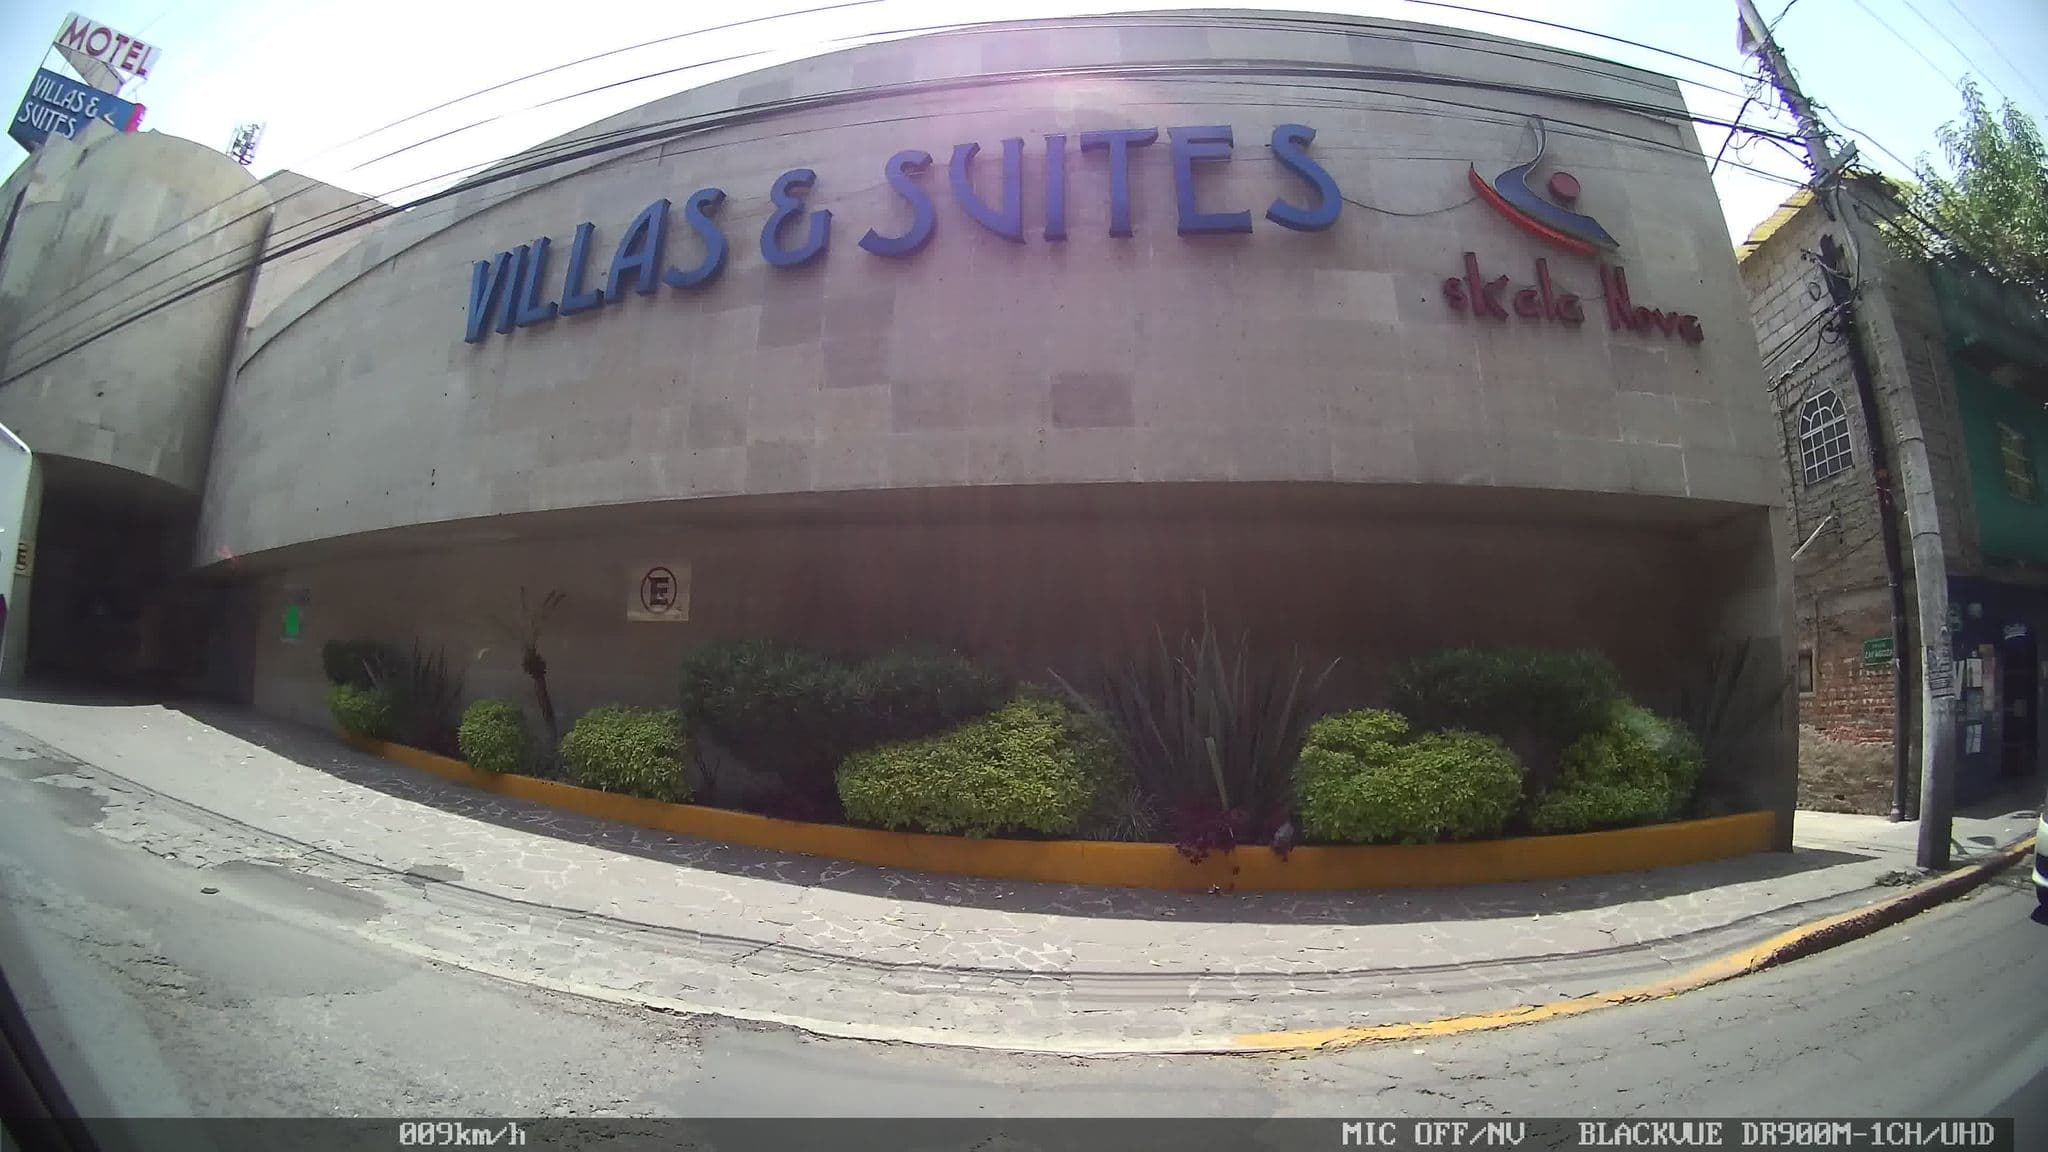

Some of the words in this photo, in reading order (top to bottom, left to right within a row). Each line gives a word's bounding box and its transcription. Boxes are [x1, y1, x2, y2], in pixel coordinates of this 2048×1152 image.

[58, 15, 152, 76] MOTEL
[17, 101, 77, 139] SUITES
[31, 74, 87, 114] VILLAS
[85, 96, 100, 118] &
[464, 187, 728, 344] VILLAS
[760, 169, 834, 270] &
[858, 124, 1344, 259] SUITES
